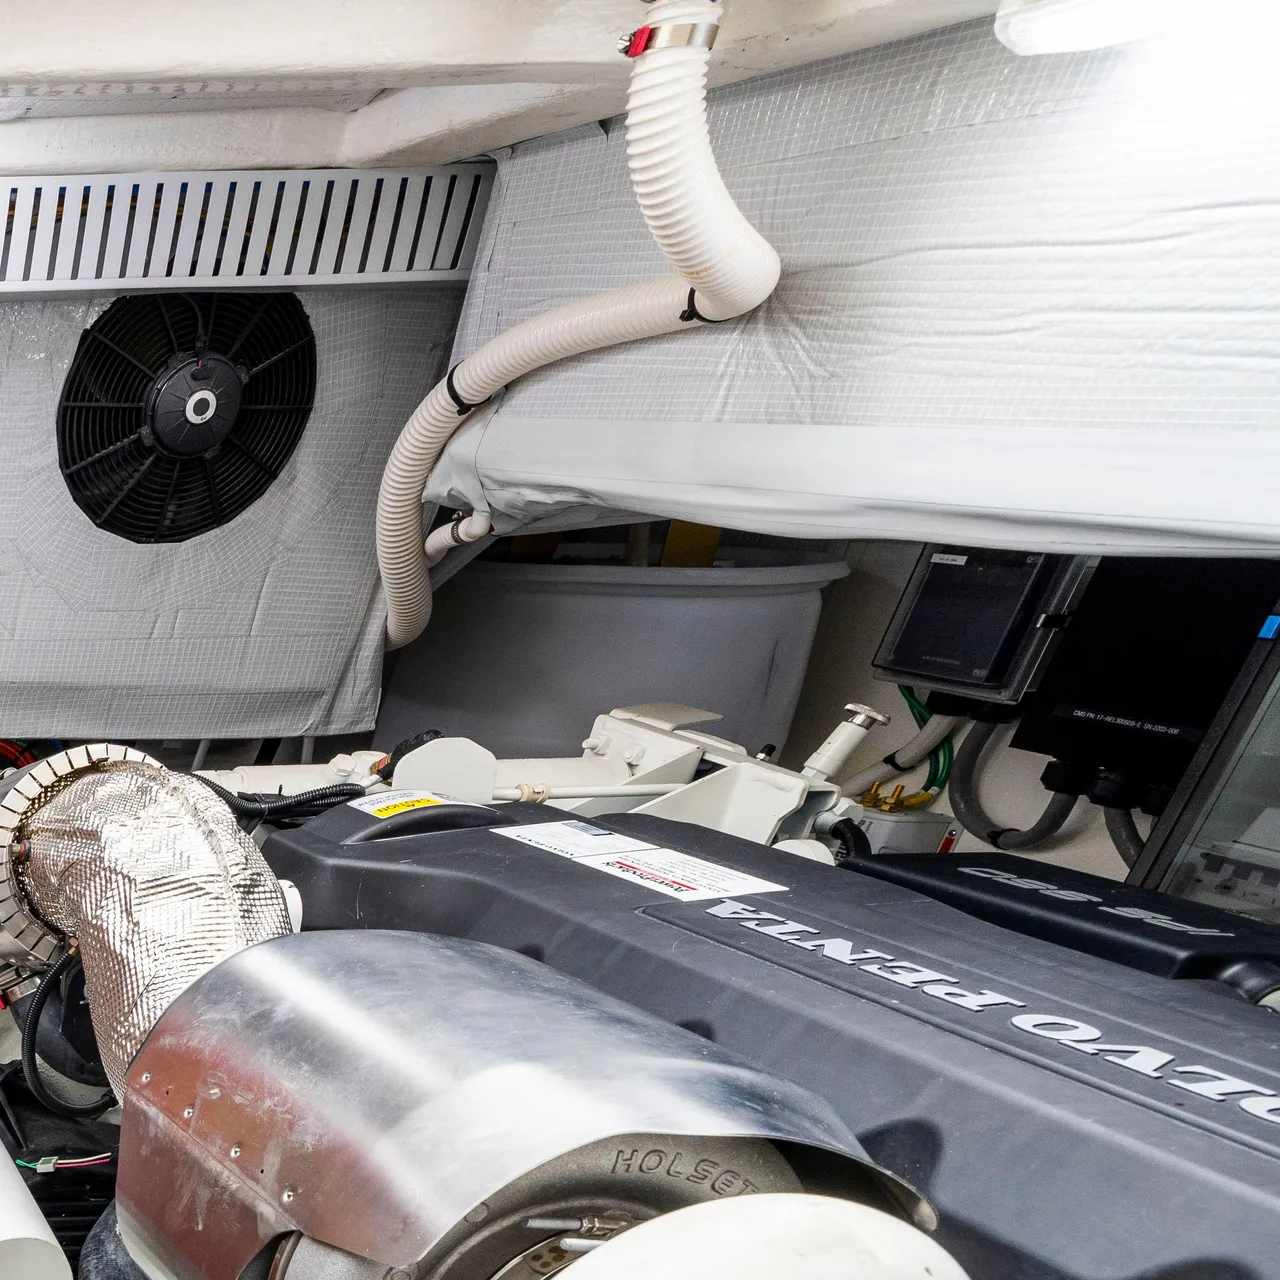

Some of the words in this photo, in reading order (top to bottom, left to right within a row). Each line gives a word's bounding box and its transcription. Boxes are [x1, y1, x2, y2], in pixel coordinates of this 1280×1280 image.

[1097, 906, 1236, 937] IPS
[704, 898, 1026, 1012] PENTA
[610, 1149, 760, 1196] HOLSET
